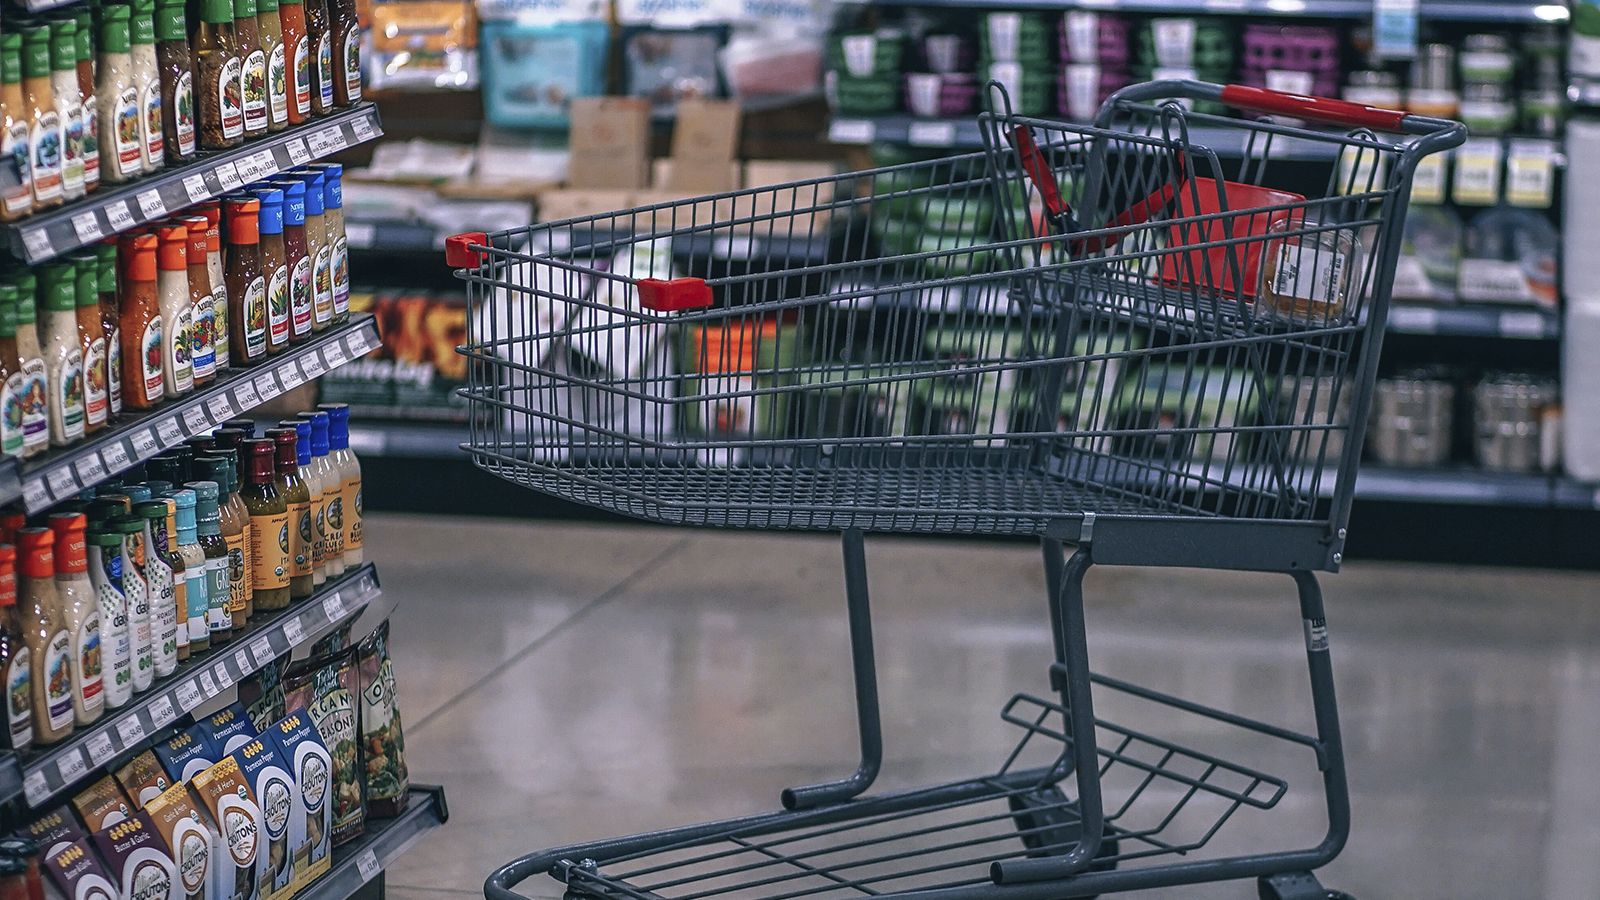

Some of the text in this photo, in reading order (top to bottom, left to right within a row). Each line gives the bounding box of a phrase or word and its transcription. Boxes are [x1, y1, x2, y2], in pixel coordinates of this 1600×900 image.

[311, 692, 352, 721] RGAN
[282, 732, 300, 748] Parmesan
[298, 726, 311, 740] Pepper
[319, 716, 355, 740] EASONE
[170, 751, 190, 765] Parmesan
[244, 751, 274, 774] Parmesan Pepper
[222, 778, 236, 790] Herb
[302, 772, 328, 794] CROUTONS
[264, 796, 292, 821] CROUTONS
[134, 832, 150, 844] Garlic
[228, 822, 258, 848] CROUTONS
[180, 847, 209, 875] CROUTONS
